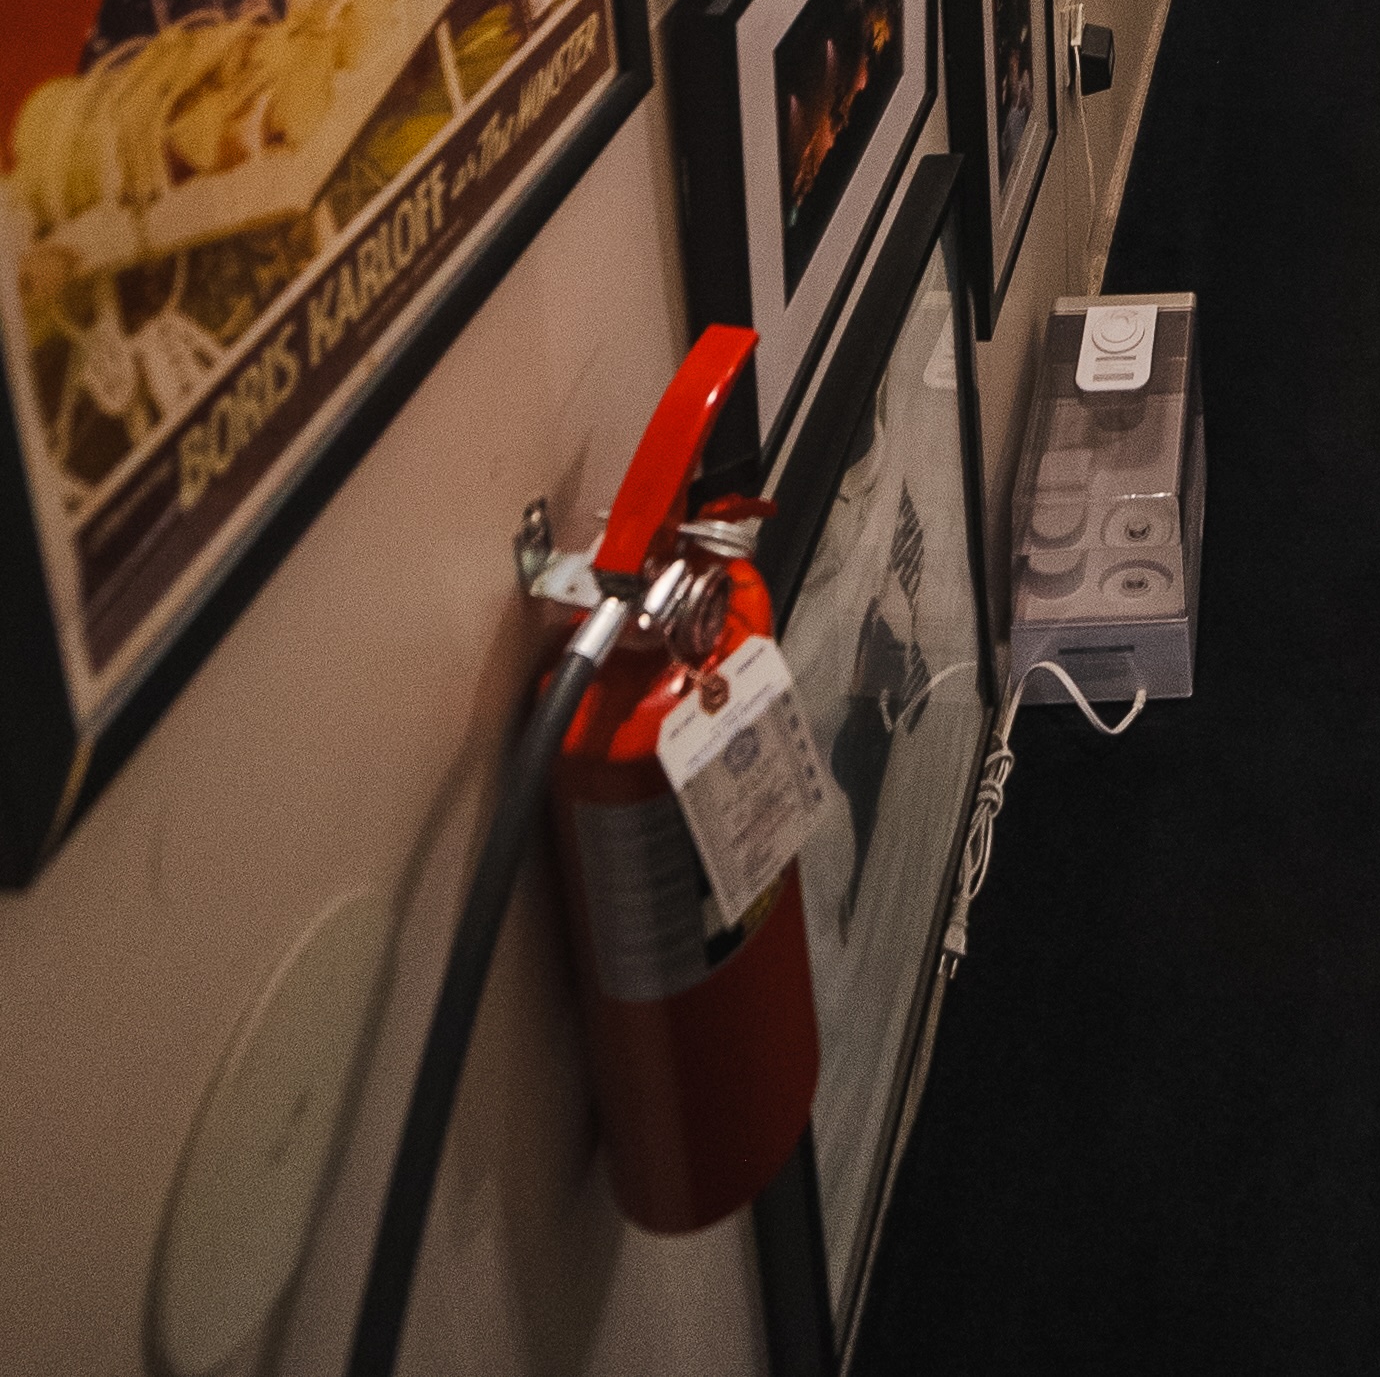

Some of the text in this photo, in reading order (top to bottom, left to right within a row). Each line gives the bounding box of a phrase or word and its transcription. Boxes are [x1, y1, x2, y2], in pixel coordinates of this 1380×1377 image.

[178, 320, 300, 512] BORIS
[306, 160, 445, 366] KARLOFF
[517, 11, 600, 136] MONSTER
